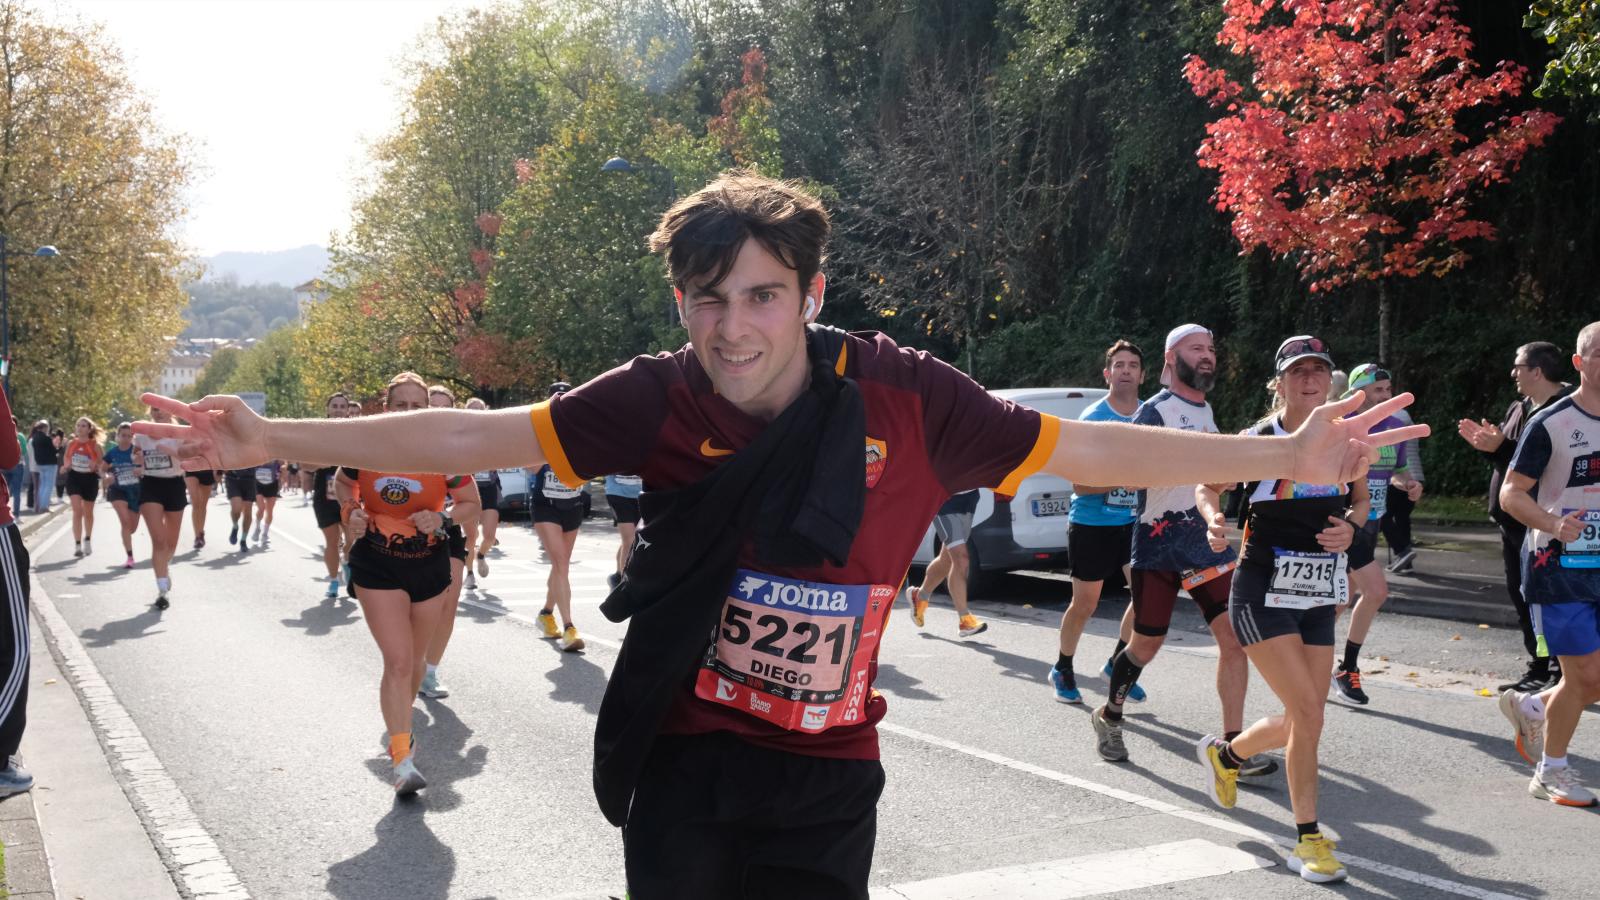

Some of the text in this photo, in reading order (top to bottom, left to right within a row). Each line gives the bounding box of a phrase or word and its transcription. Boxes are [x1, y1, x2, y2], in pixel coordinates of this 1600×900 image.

[1040, 500, 1066, 513] 3924
[1281, 561, 1333, 581] 17315
[871, 587, 893, 598] 5221
[1291, 582, 1317, 590] ZURINE
[722, 605, 847, 665] 5221
[750, 659, 812, 687] DIEGO
[844, 669, 867, 721] 5221
[750, 696, 772, 709] DIARIO
[750, 701, 770, 714] VASCO
